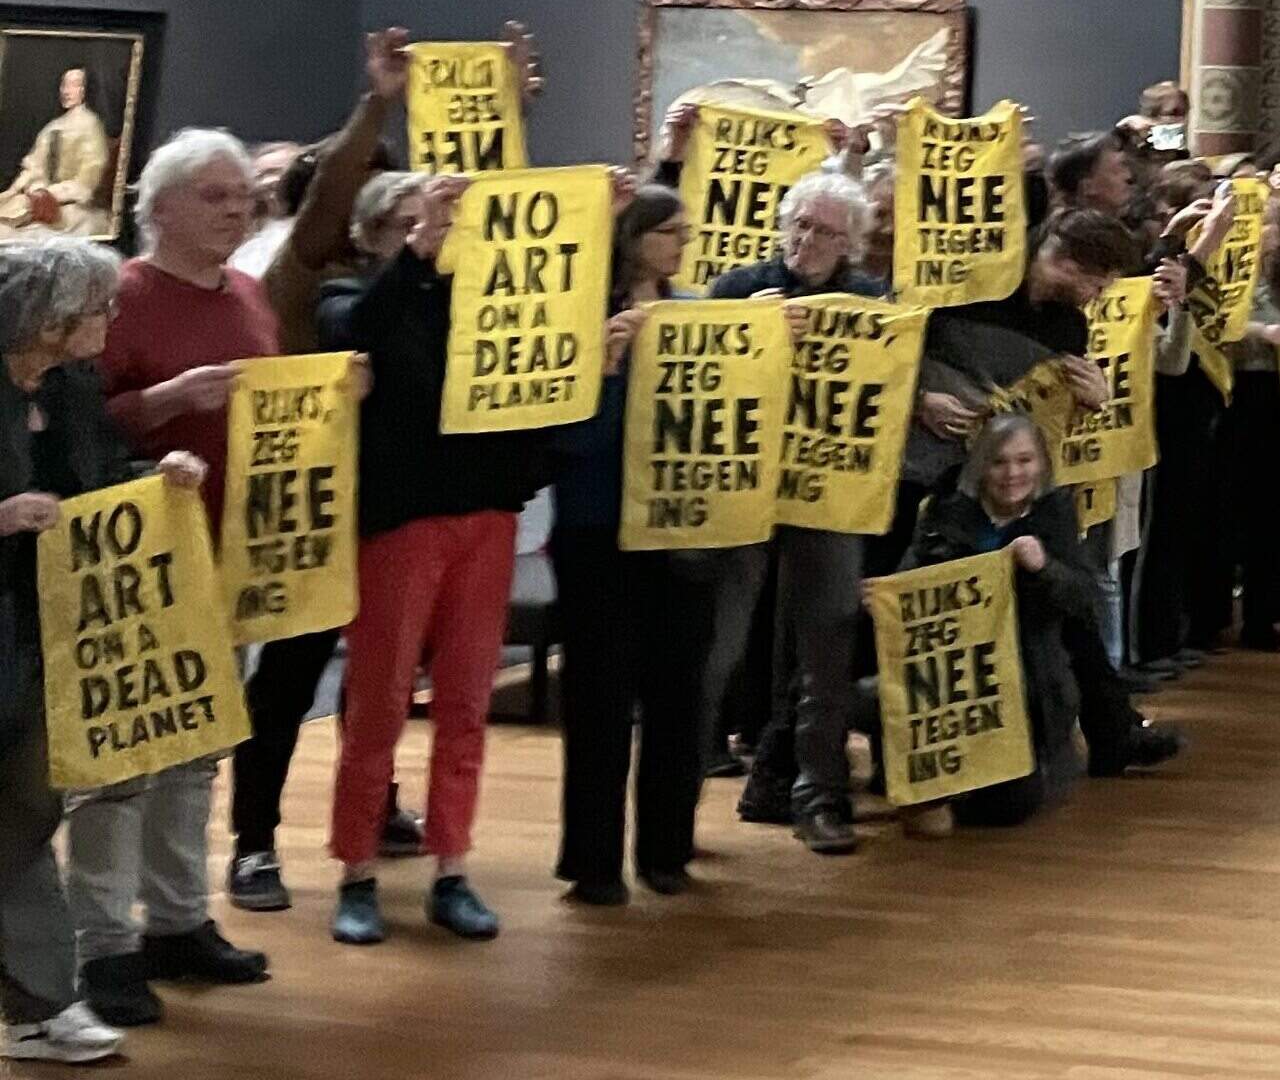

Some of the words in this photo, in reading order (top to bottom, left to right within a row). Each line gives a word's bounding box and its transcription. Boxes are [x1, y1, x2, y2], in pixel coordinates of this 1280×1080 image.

[715, 118, 807, 156] RIJKS,
[922, 143, 975, 171] ZEG
[711, 147, 767, 176] ZEG
[482, 190, 559, 242] NO
[917, 174, 1005, 224] NEE
[699, 231, 784, 260] TEGE
[917, 227, 1005, 255] TEGEN
[484, 242, 580, 297] ART
[914, 260, 972, 286] ING
[477, 302, 521, 333] ON
[530, 301, 548, 329] A
[472, 332, 579, 378] DEAD
[657, 322, 764, 359] RIJKS,
[467, 375, 577, 412] PLANET
[656, 361, 722, 394] ZEG
[653, 398, 761, 455] NEE
[786, 374, 885, 437] NEE
[250, 428, 298, 467] ZEG
[781, 430, 875, 471] TEGEN
[651, 460, 759, 491] TEGEN
[246, 465, 335, 540] NEE
[649, 497, 708, 528] ING
[70, 501, 144, 573] NO
[76, 552, 175, 633] ART
[899, 575, 993, 623] RIJKS,
[74, 624, 125, 670] ON
[137, 622, 160, 653] A
[904, 616, 959, 658] ZEG
[79, 649, 208, 720] DEAD
[903, 640, 1002, 715] NEE
[86, 694, 217, 760] PLANET
[908, 699, 1004, 750] TEGEN
